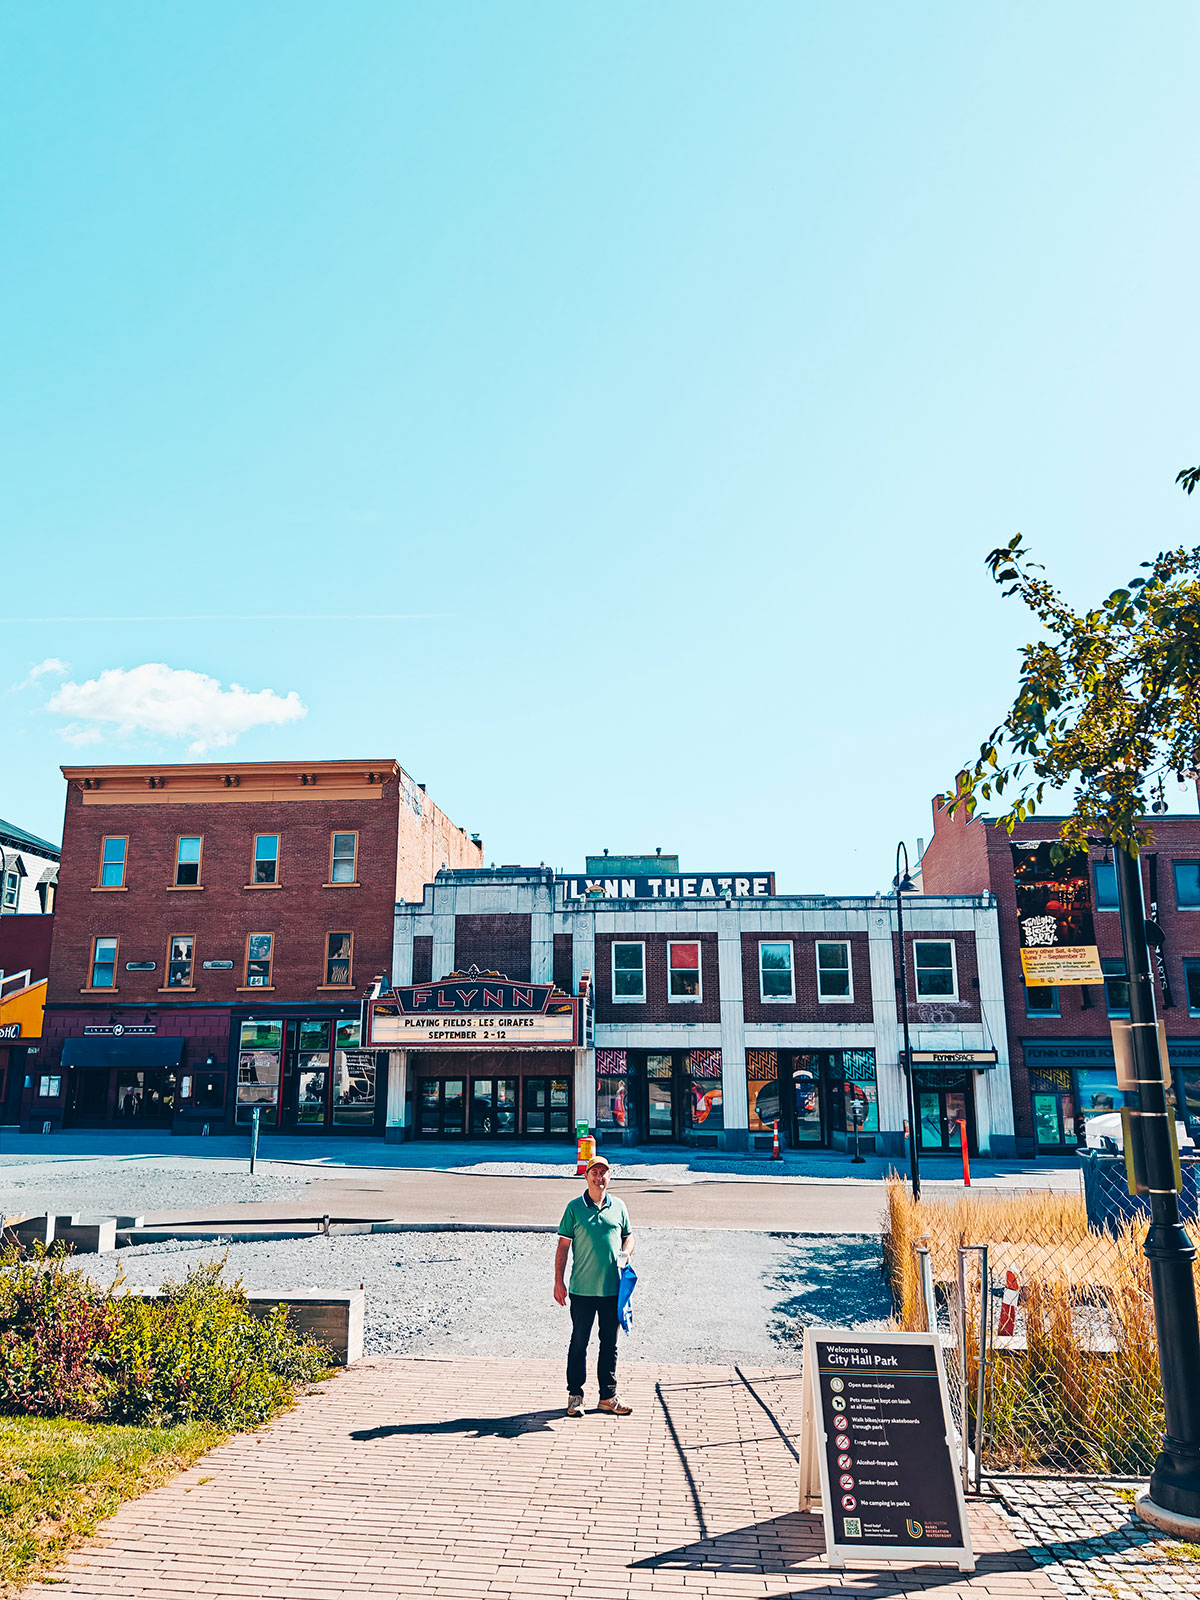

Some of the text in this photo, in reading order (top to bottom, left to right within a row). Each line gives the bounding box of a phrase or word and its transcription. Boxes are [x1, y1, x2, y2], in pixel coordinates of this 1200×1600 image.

[564, 877, 769, 898] LYNN THEATRE
[413, 988, 533, 1008] FLYNN
[404, 1019, 440, 1027] PLAYING
[498, 1018, 535, 1027] GIRAFES
[428, 1031, 477, 1039] SEPTEMBER
[1028, 1050, 1058, 1058] FLYNN
[1060, 1050, 1096, 1058] CENTER
[826, 1346, 859, 1354] Welcome
[828, 1354, 898, 1366] City Hall Park
